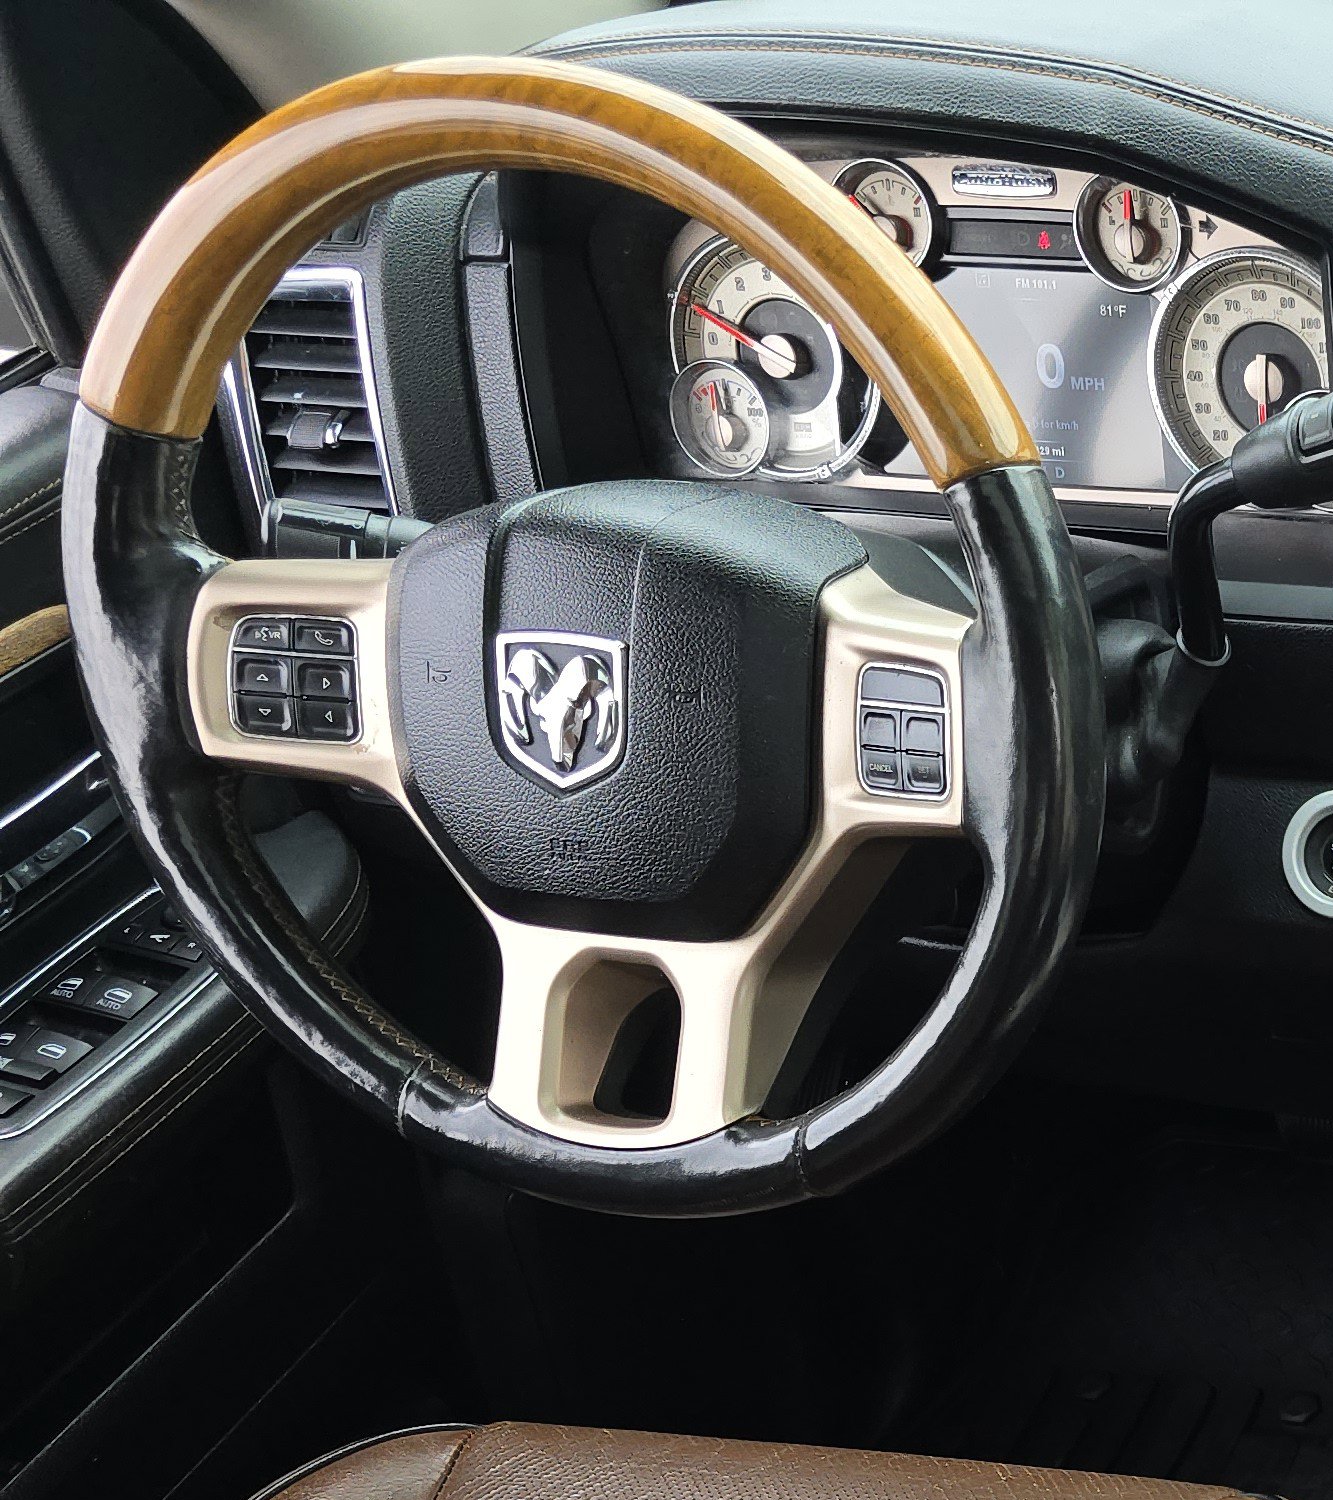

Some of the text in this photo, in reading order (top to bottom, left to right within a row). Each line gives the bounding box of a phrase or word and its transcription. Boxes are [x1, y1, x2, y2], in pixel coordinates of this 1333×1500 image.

[734, 276, 746, 292] 2
[1015, 277, 1057, 290] FM 101.1
[1250, 289, 1267, 302] 80
[716, 299, 725, 315] 1
[1224, 299, 1242, 312] 70
[1279, 297, 1296, 309] 90
[1099, 304, 1127, 318] 81°F
[1202, 313, 1220, 326] 60
[1300, 317, 1322, 330] 100
[707, 331, 719, 346] 0
[1190, 339, 1208, 352] 50
[1036, 343, 1065, 389] 0
[1186, 370, 1204, 382] 40
[1070, 376, 1105, 391] MPH
[1194, 402, 1212, 415] 30
[1056, 420, 1079, 431] km/h
[1212, 429, 1229, 441] 20
[1054, 466, 1065, 479] D
[869, 762, 894, 774] CANCEL
[50, 988, 75, 999] AUTO
[96, 998, 122, 1010] AUTO
